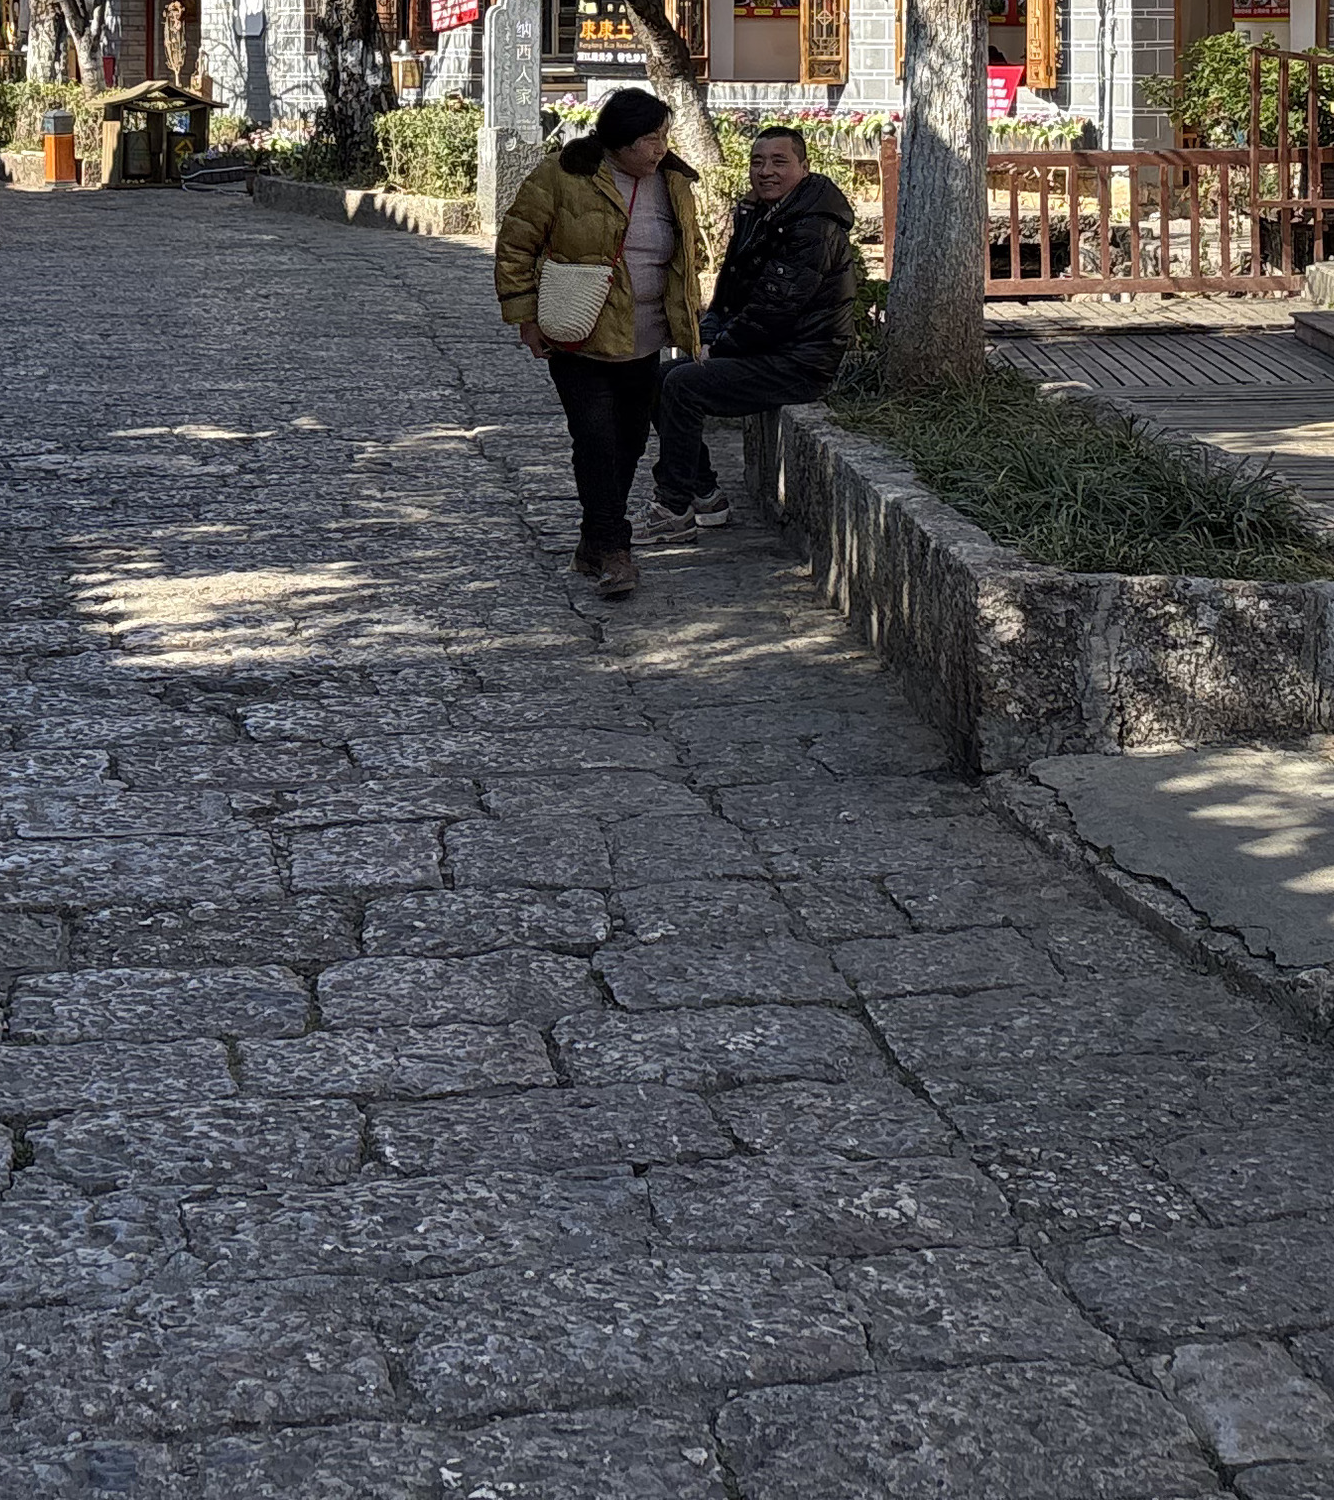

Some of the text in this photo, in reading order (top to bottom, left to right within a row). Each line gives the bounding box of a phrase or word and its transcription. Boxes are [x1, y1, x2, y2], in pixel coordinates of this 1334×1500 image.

[579, 18, 638, 41] 康康土
[515, 20, 532, 106] 纳西人家
